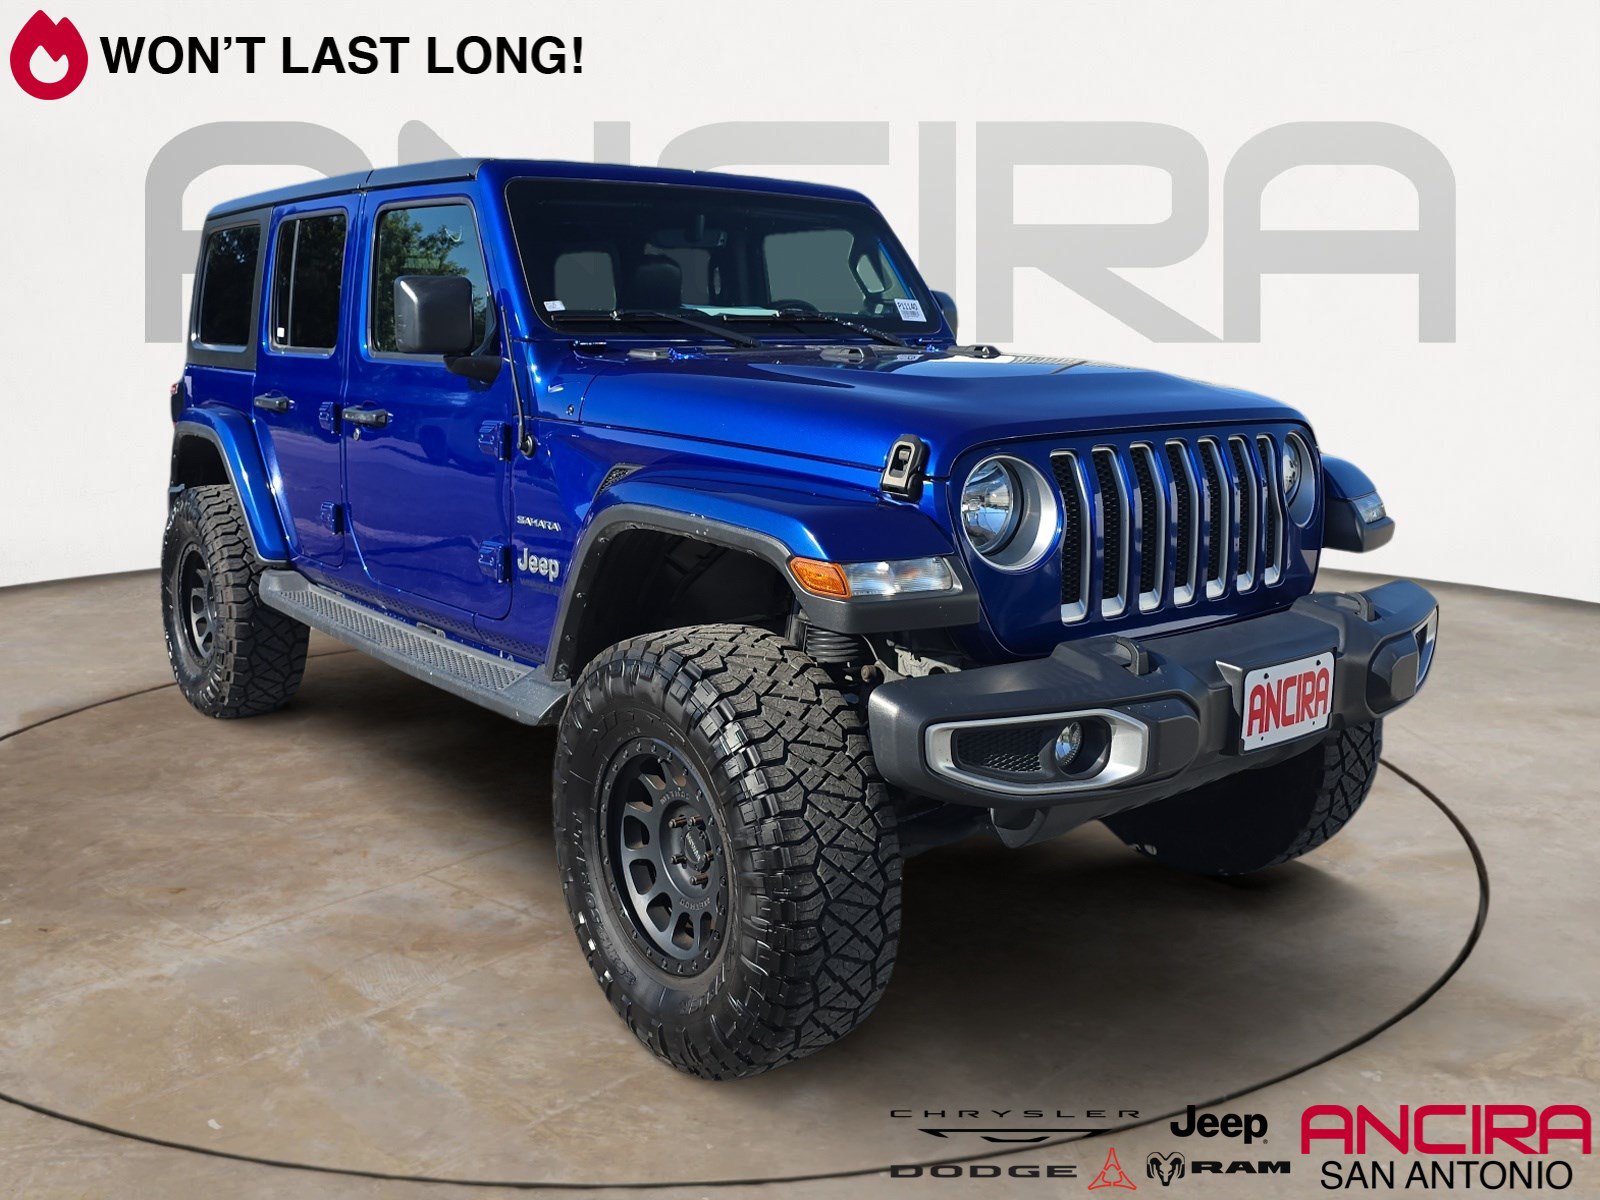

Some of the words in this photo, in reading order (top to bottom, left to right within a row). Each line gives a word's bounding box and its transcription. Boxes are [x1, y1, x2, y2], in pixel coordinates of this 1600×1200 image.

[145, 121, 1456, 343] AIRA
[516, 515, 561, 532] SAHARA
[517, 547, 559, 582] Jeep
[1246, 667, 1330, 737] ANCIRA
